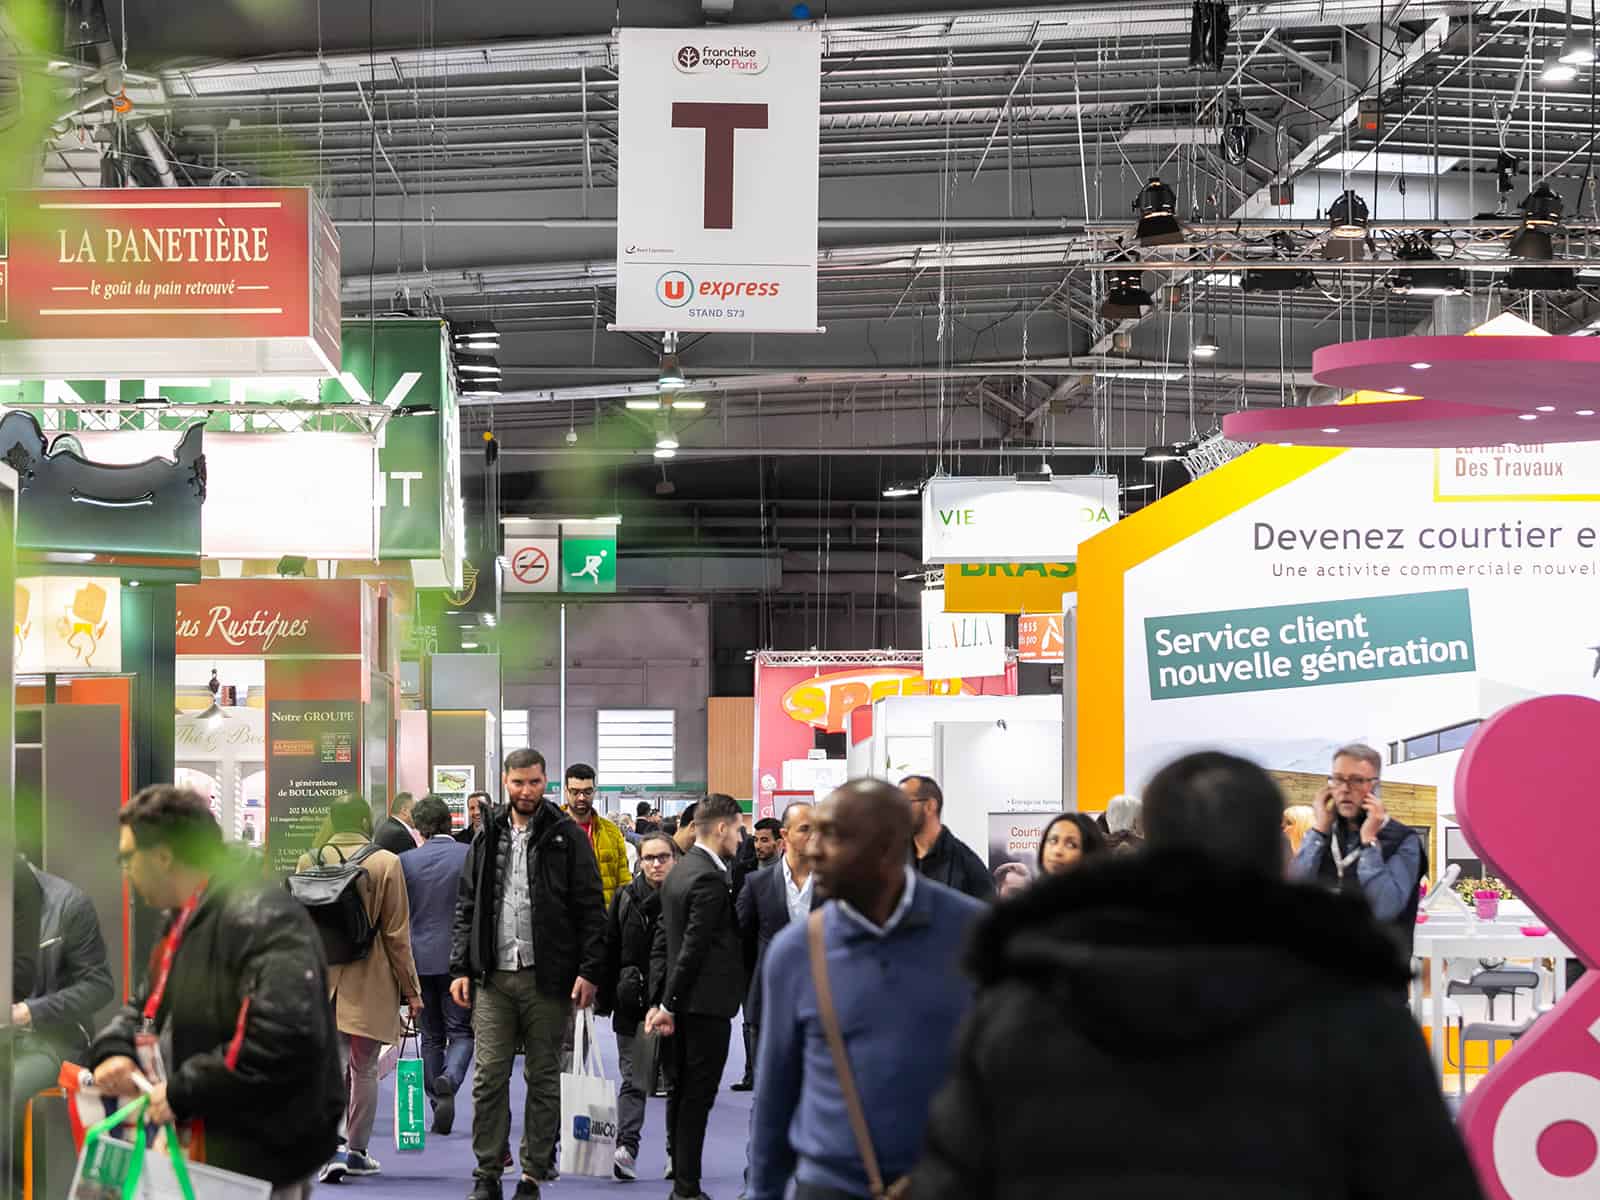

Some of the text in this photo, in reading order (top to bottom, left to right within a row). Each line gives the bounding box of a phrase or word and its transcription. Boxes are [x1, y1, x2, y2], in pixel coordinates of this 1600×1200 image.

[702, 46, 756, 57] franchise
[672, 102, 768, 229] T
[59, 217, 269, 263] LA PANETIÈRE
[90, 279, 235, 300] le goût du pain retrouvé
[699, 281, 779, 300] express
[688, 309, 723, 318] STAND
[1456, 456, 1563, 477] Des Travaux
[1254, 522, 1404, 550] Devenez
[1418, 520, 1562, 549] courtier
[1272, 563, 1308, 576] Une
[1400, 560, 1522, 576] commerciale
[205, 605, 310, 651] Rustiques
[1155, 613, 1368, 656] Service client
[1159, 637, 1468, 687] nouvelle génération
[272, 712, 353, 722] Notre GROUPE
[278, 789, 287, 797] de
